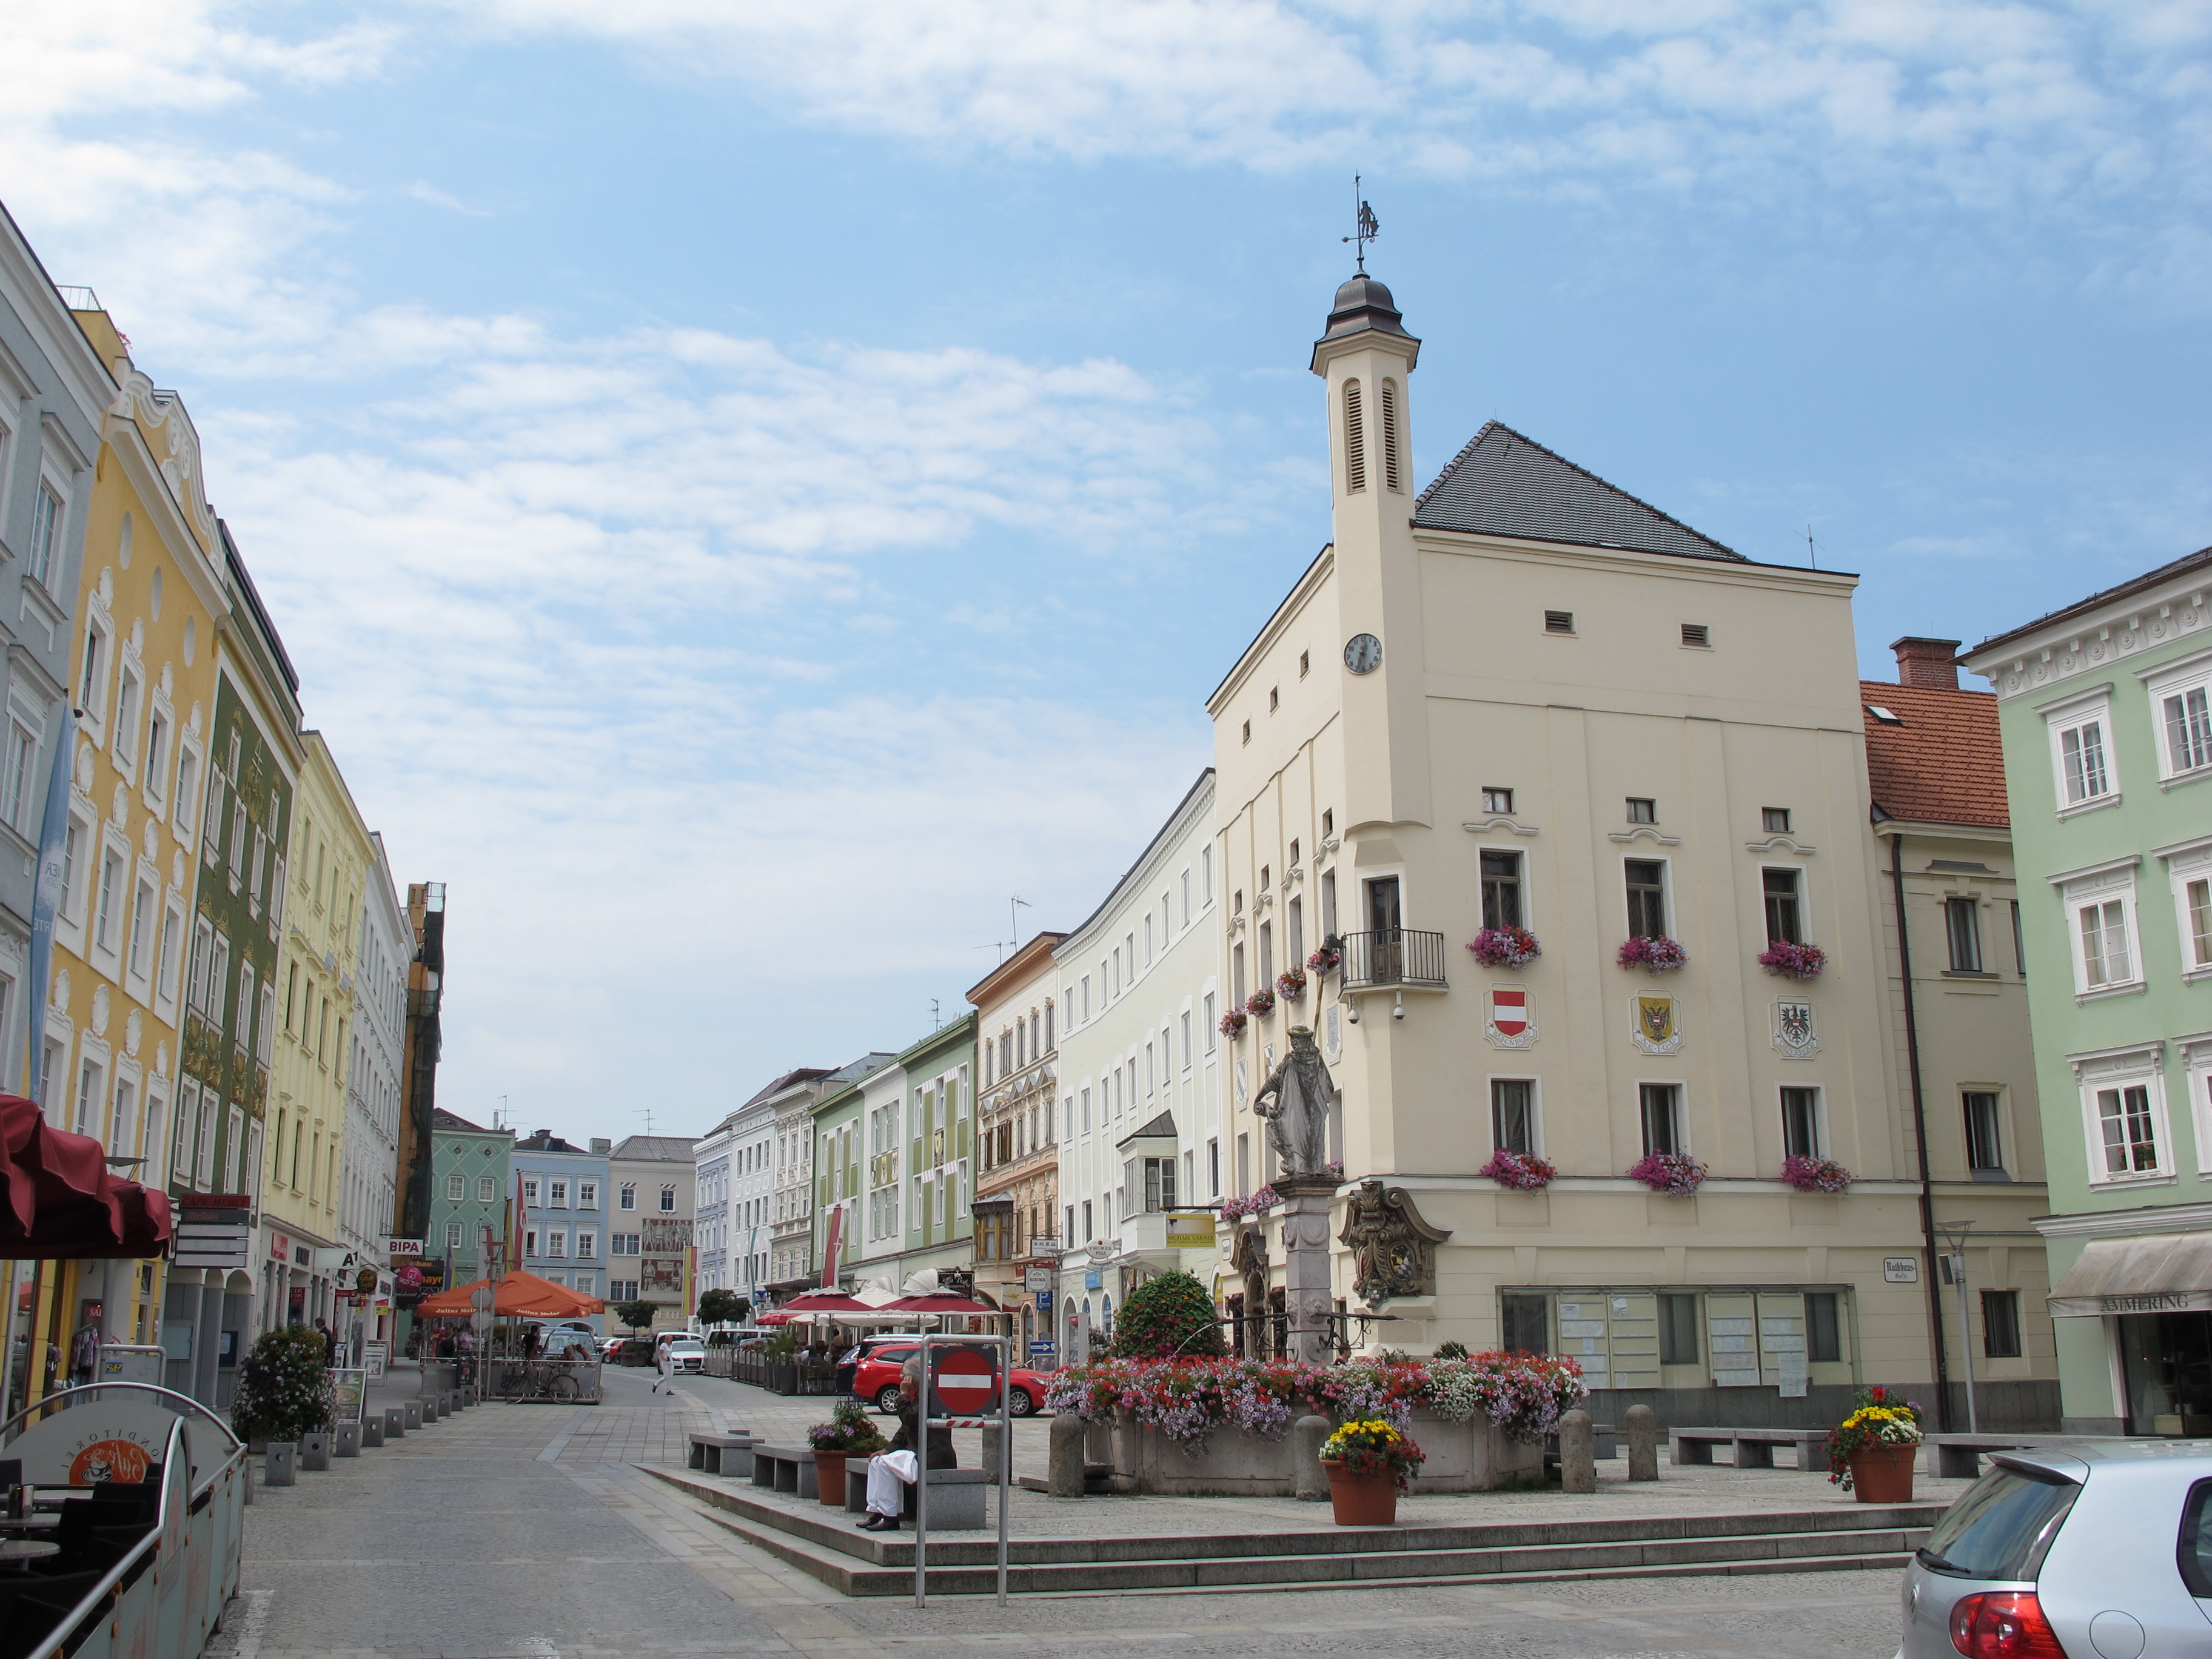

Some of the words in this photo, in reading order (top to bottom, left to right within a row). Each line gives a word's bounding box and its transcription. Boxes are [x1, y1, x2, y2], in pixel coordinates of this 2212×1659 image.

[1492, 1030, 1530, 1046] BABENBERG
[389, 1241, 419, 1252] BIPA
[342, 1251, 358, 1266] A1
[1039, 1292, 1048, 1302] P
[2101, 1295, 2188, 1312] AMMERING
